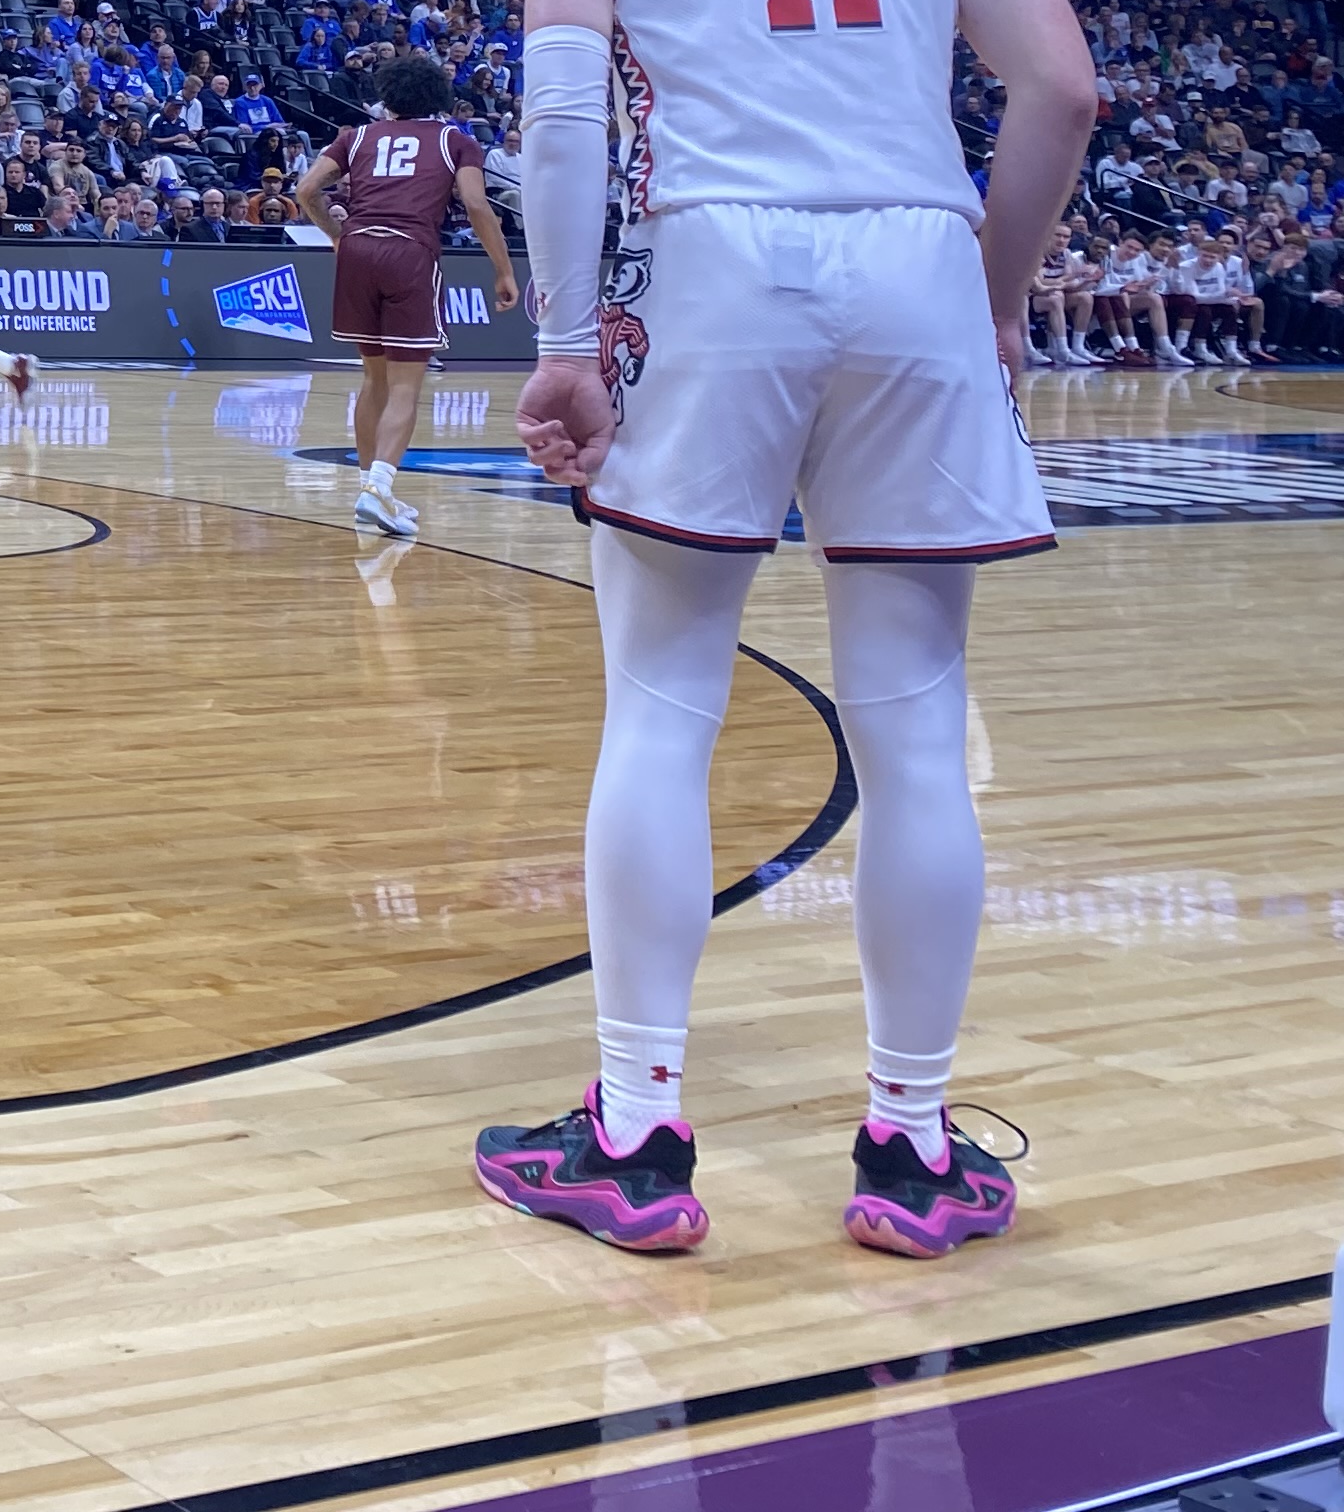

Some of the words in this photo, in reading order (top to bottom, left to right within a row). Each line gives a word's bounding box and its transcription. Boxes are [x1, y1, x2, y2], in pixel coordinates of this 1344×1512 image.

[372, 135, 421, 177] 12
[13, 222, 36, 234] POSS.
[14, 314, 97, 333] CONFERENCE
